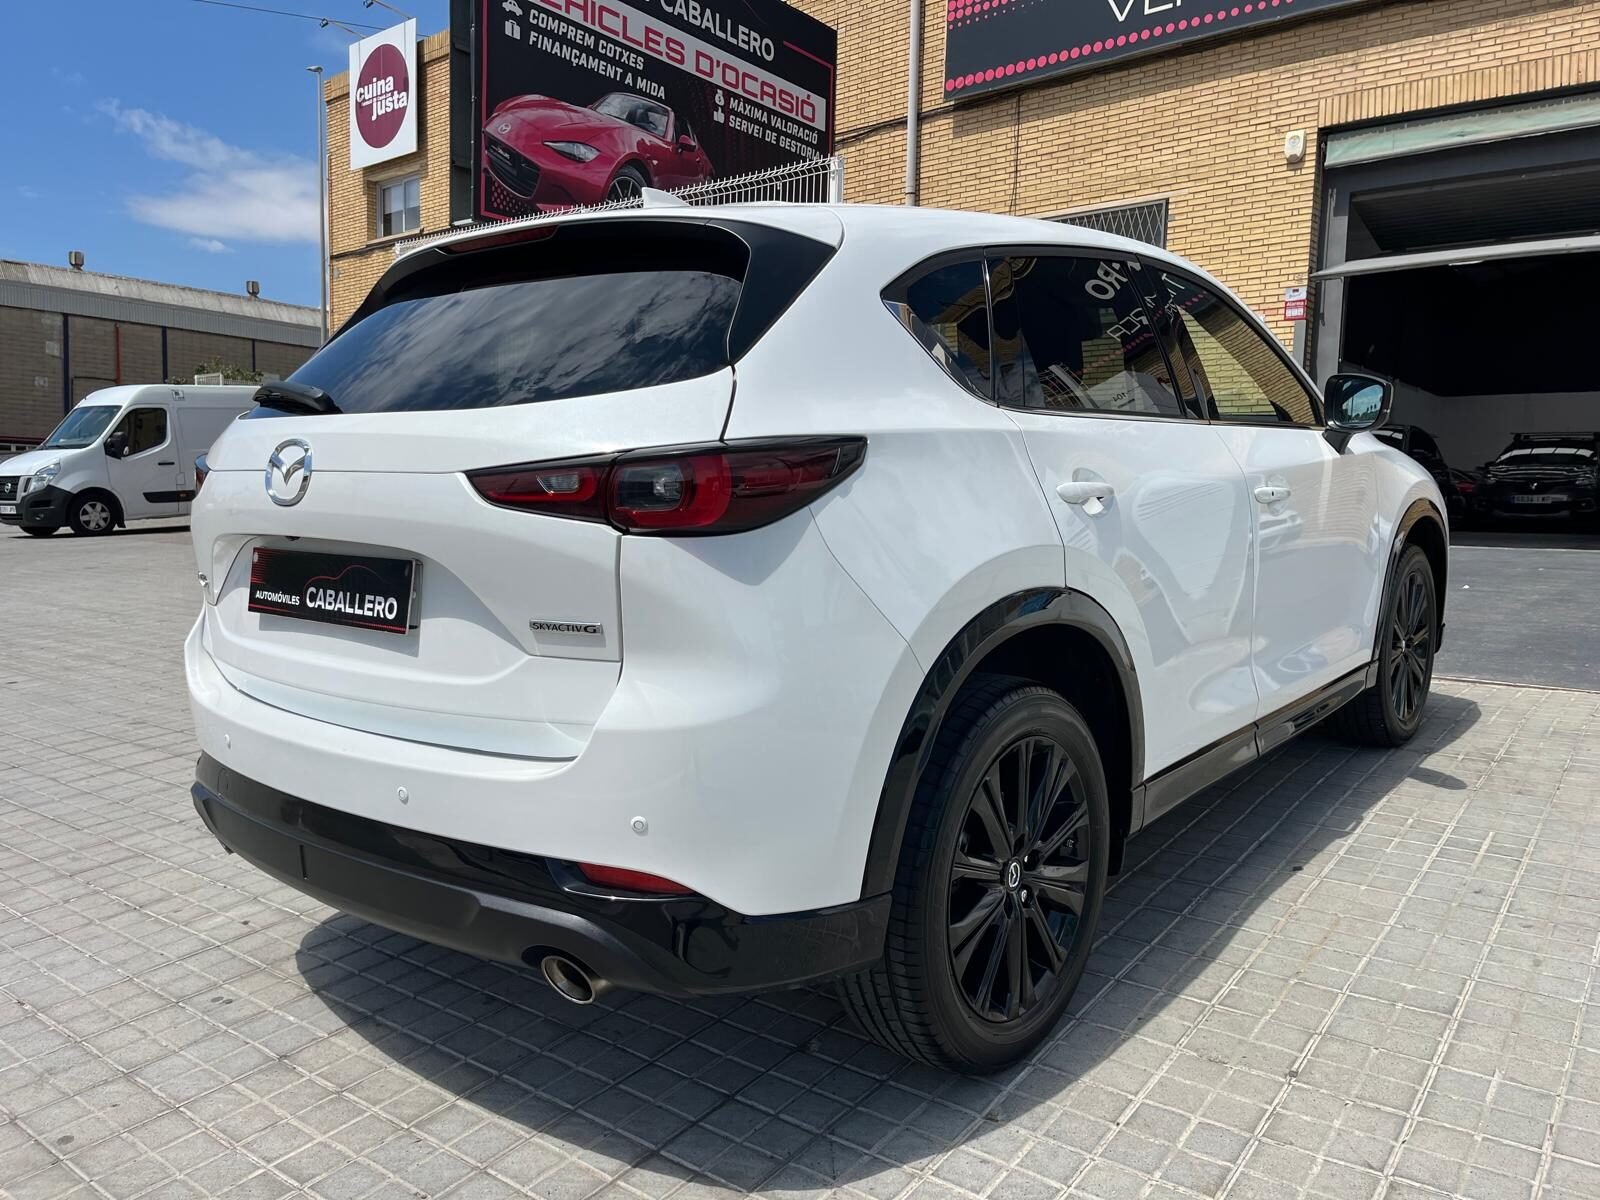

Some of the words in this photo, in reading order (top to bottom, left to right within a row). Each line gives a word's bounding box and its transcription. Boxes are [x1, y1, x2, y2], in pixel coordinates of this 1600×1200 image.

[530, 9, 595, 49] COMPREM
[599, 39, 645, 71] COTXES
[529, 31, 623, 81] FINANÇAMENT
[625, 72, 633, 87] A
[636, 76, 666, 100] MIDA
[356, 76, 394, 103] cuina
[371, 91, 408, 121] justa
[728, 115, 763, 139] SERVEI
[765, 129, 777, 145] DE
[729, 97, 768, 124] MÀXIMA
[770, 114, 818, 145] VALORACIÓ
[255, 590, 300, 606] AUTOMÓVILES
[306, 586, 398, 620] CABALLERO
